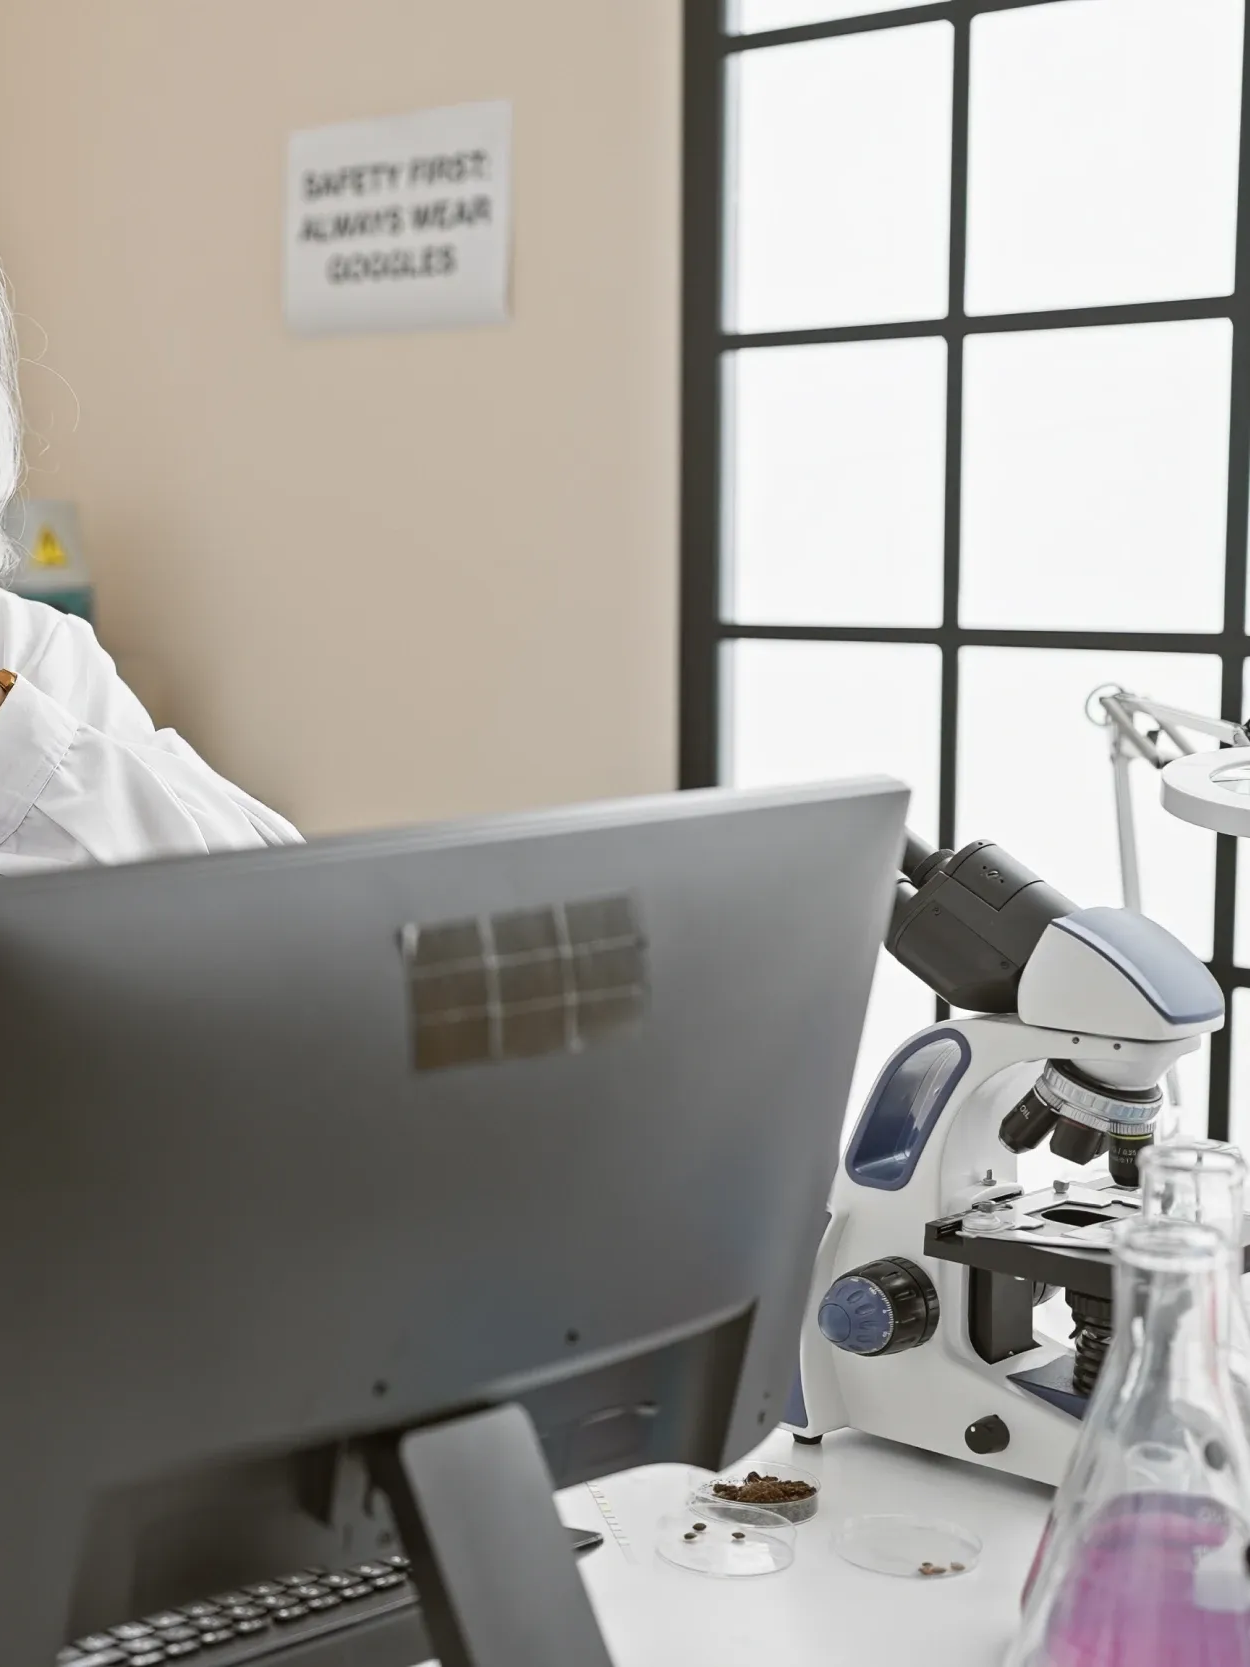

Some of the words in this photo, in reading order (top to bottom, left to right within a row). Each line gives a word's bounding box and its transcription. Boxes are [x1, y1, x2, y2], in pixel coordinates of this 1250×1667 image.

[303, 164, 400, 199] SAFETY
[300, 205, 403, 241] ALWAYS
[410, 195, 491, 230] WEAR
[325, 244, 457, 283] GOGGLES
[1019, 1104, 1030, 1120] OIL
